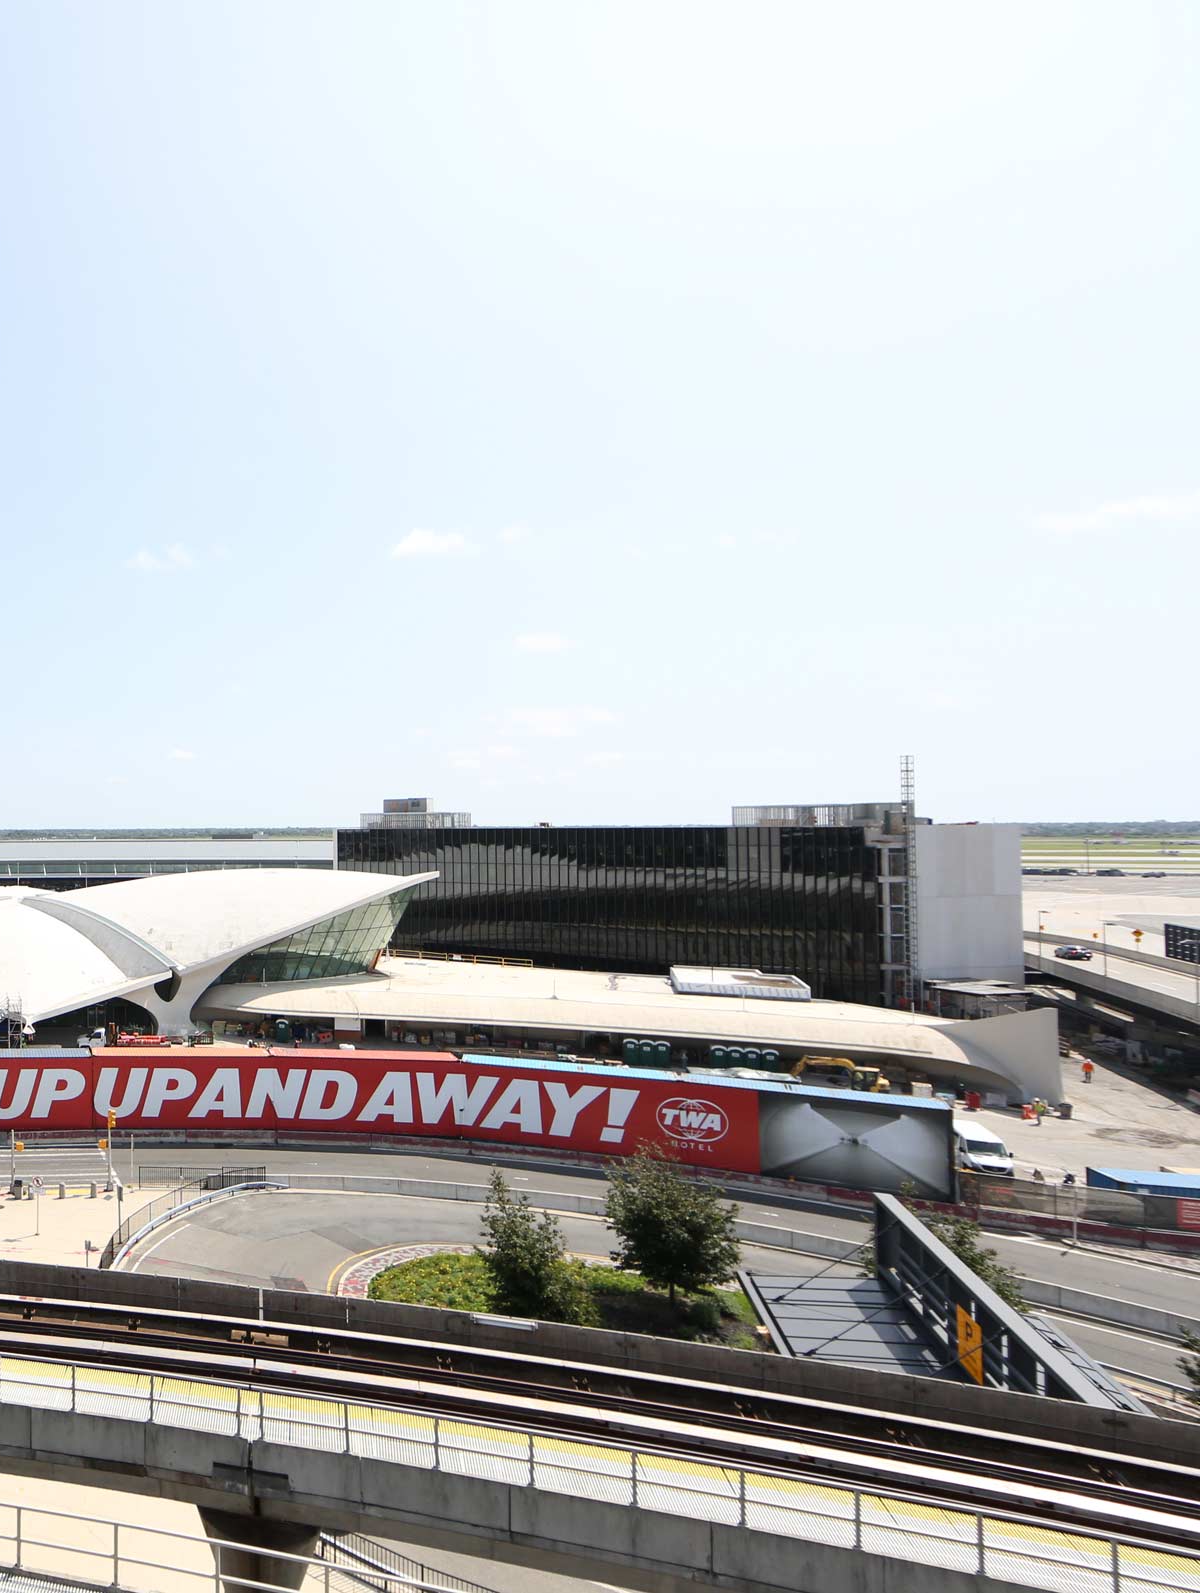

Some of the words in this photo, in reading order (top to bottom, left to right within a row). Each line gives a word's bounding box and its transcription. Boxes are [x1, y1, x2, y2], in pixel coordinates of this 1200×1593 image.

[93, 1067, 198, 1119] UP
[187, 1067, 358, 1121] AND
[355, 1071, 640, 1143] AWAY!
[662, 1108, 721, 1132] TWA
[671, 1140, 714, 1153] HOTEL
